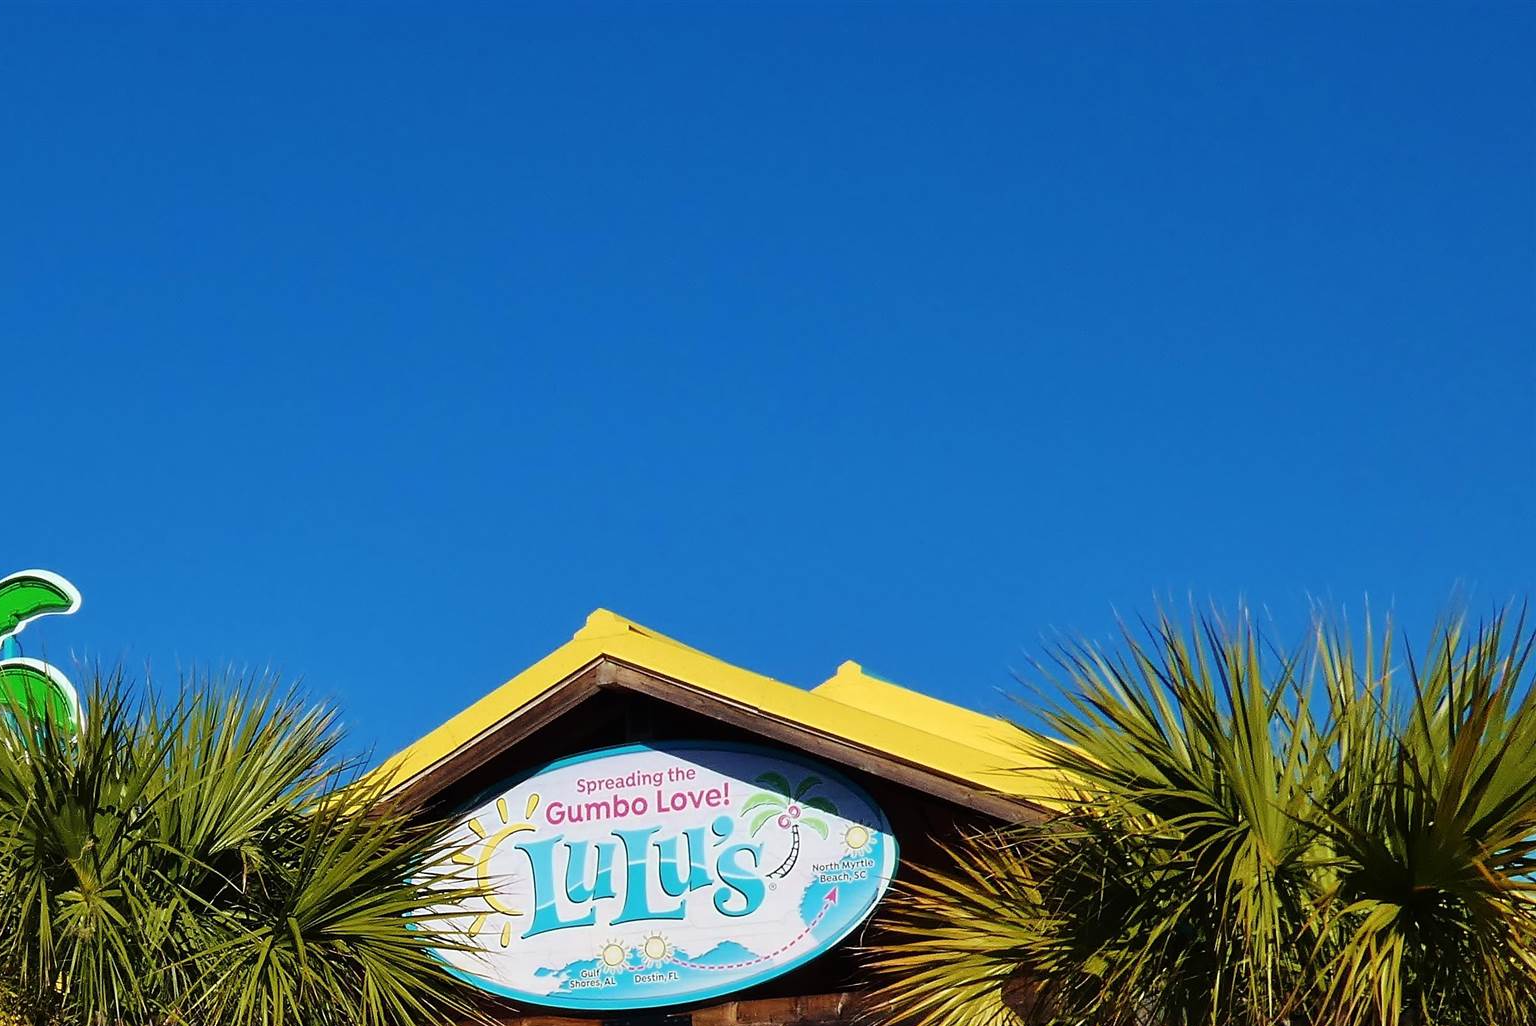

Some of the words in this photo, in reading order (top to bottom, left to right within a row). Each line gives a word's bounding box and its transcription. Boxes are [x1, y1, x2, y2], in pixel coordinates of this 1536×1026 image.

[576, 770, 664, 796] Spreading
[667, 767, 697, 783] the
[545, 793, 649, 826] Gumbo
[656, 782, 731, 814] Love!
[812, 862, 840, 872] North
[842, 858, 874, 871] Myrtle
[514, 814, 764, 940] LuLu's
[820, 873, 852, 883] Beach,
[854, 870, 866, 880] SC
[580, 968, 600, 978] Gulf
[634, 972, 667, 983] Destin,
[668, 971, 679, 980] FL
[569, 978, 603, 989] Shores,
[604, 977, 616, 985] AL
